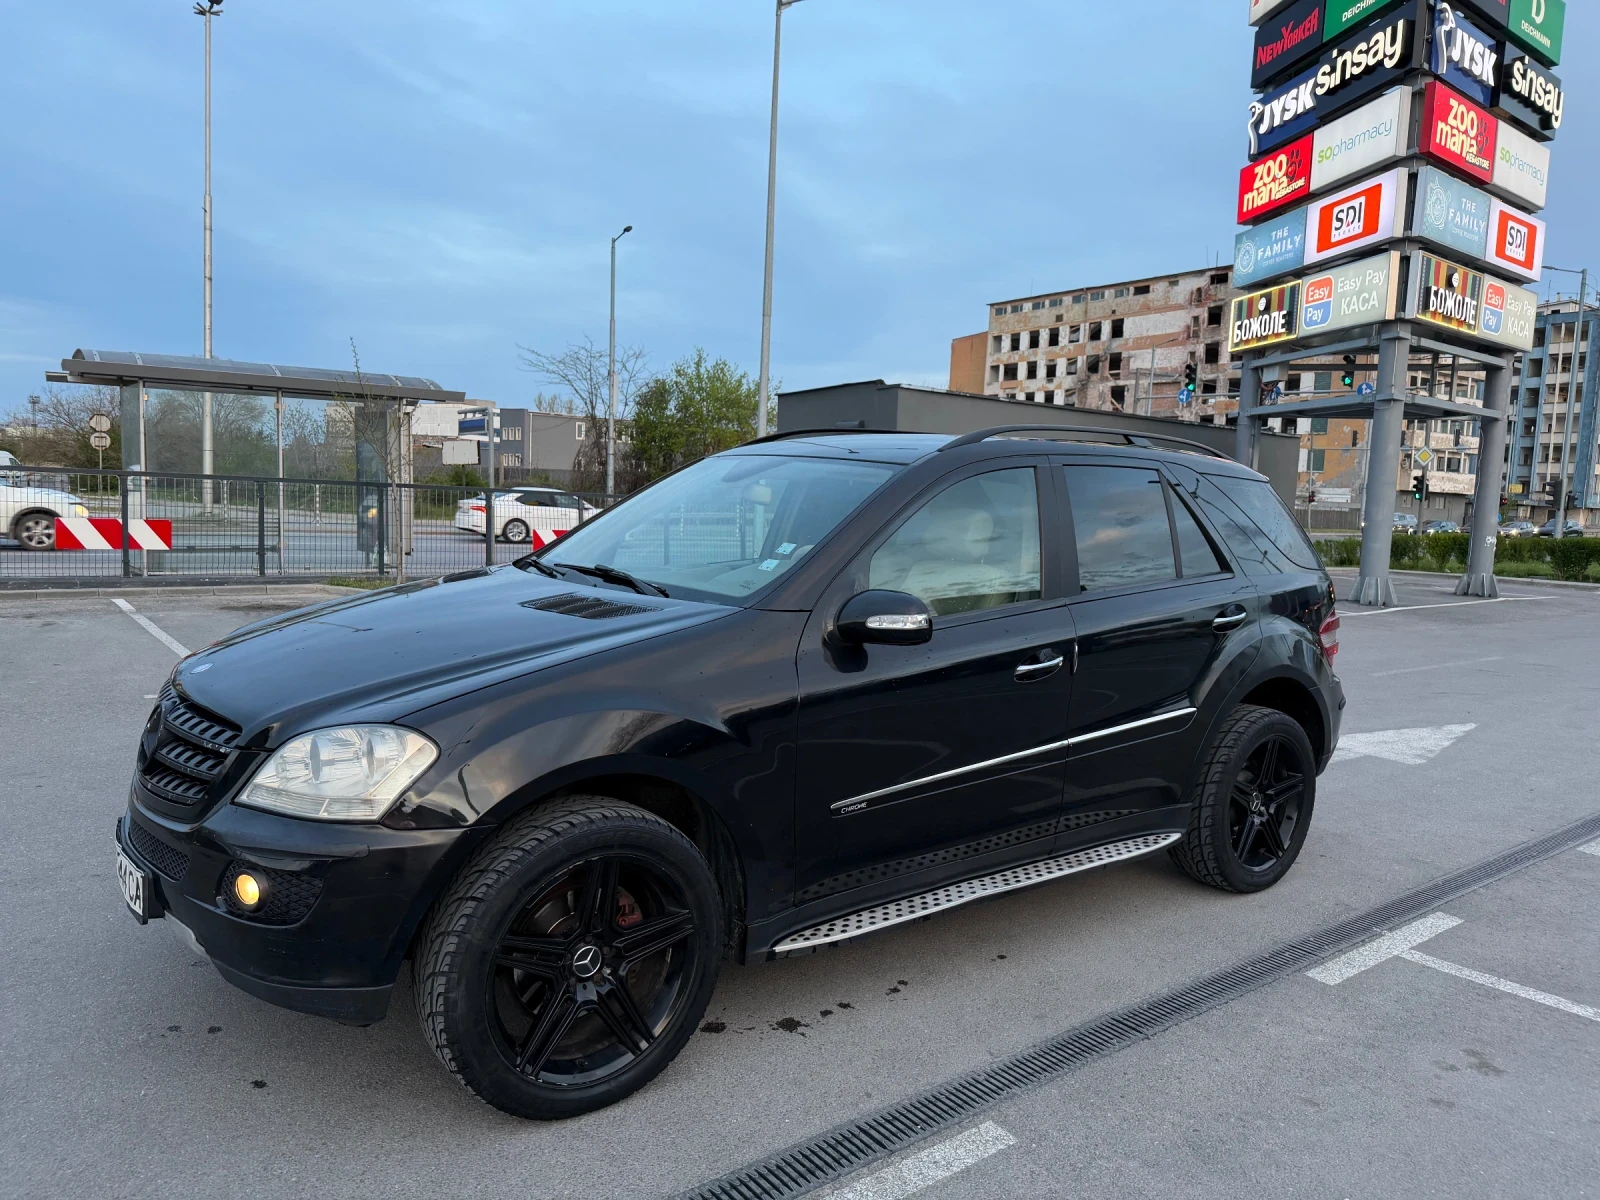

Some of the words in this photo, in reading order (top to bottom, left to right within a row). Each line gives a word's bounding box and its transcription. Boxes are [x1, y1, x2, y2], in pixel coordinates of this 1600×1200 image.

[1521, 19, 1551, 48] DEICHMANN
[1315, 18, 1404, 96] sinsay
[1451, 28, 1497, 87] JYSK
[1512, 55, 1564, 129] sinsay
[1258, 77, 1316, 135] JYSK
[1334, 201, 1363, 232] SDI
[1461, 197, 1477, 213] THE
[1448, 207, 1486, 233] FAMILY
[1257, 233, 1302, 261] FAMILY
[1271, 226, 1289, 242] THE
[1507, 225, 1526, 252] SDI
[1308, 286, 1330, 301] Easy
[1337, 277, 1362, 293] Easy
[1365, 269, 1387, 287] Pay
[1429, 286, 1477, 325] БОЖОЛЕ
[1487, 289, 1503, 309] Easy
[1506, 294, 1522, 313] Easy
[1522, 300, 1536, 319] Pay
[1233, 310, 1288, 343] БОЖОЛЕ
[1306, 306, 1324, 324] Pay
[1484, 311, 1498, 329] Pay
[841, 801, 868, 814] CHROME
